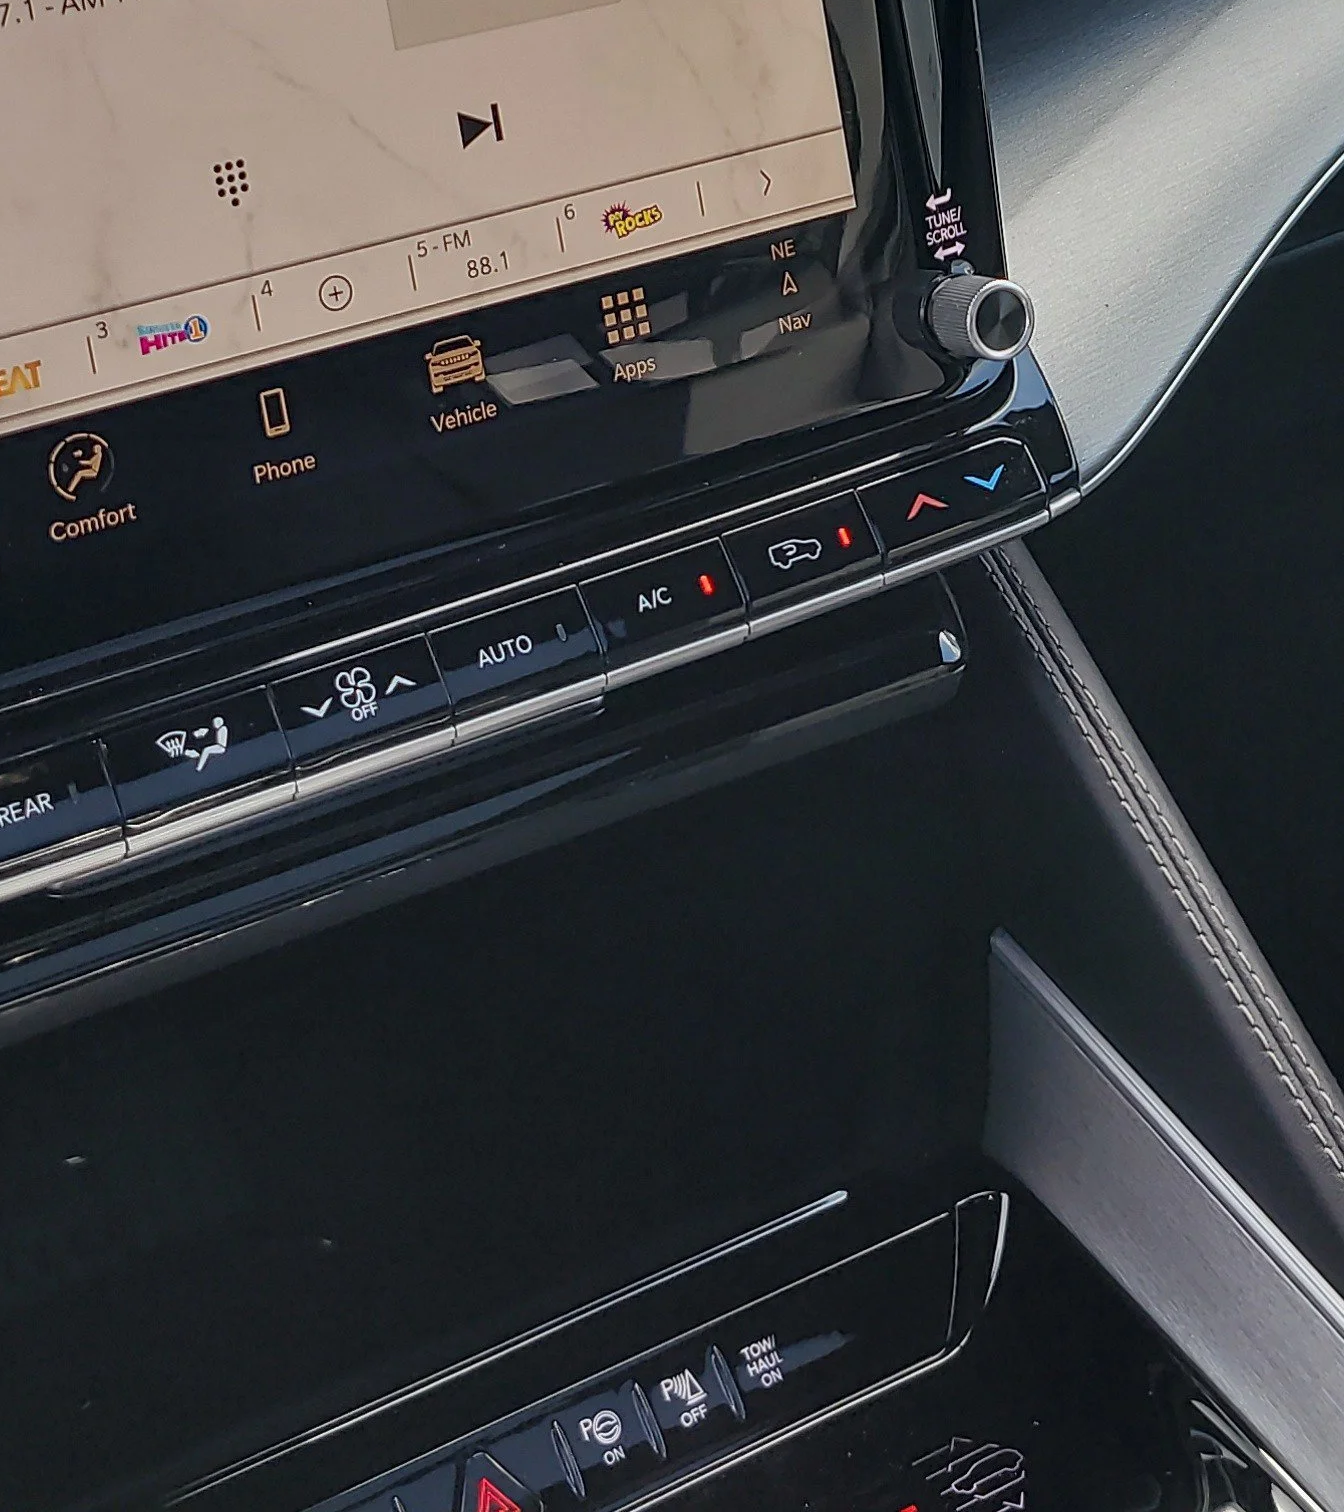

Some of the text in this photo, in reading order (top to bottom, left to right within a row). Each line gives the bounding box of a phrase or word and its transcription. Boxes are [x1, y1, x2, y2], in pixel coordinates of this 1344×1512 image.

[563, 203, 576, 220] 6
[924, 205, 962, 230] TUNE/
[416, 238, 428, 259] 5
[442, 230, 473, 253] FM
[925, 222, 968, 246] SCROLL
[769, 237, 797, 262] NE
[465, 252, 511, 281] 88.1
[260, 280, 274, 299] 4
[96, 320, 109, 340] 3
[777, 308, 813, 336] Nav
[612, 353, 657, 385] Apps
[429, 398, 498, 435] Vehicle
[253, 450, 317, 485] Phone
[48, 501, 138, 543] Comfort
[637, 586, 673, 612] A/C
[477, 634, 534, 669] AUTO
[349, 700, 380, 723] OFF
[740, 1334, 778, 1361] TOW/
[745, 1350, 784, 1379] HAUL
[759, 1368, 783, 1387] ON
[679, 1402, 709, 1427] OFF
[601, 1444, 626, 1465] ON
